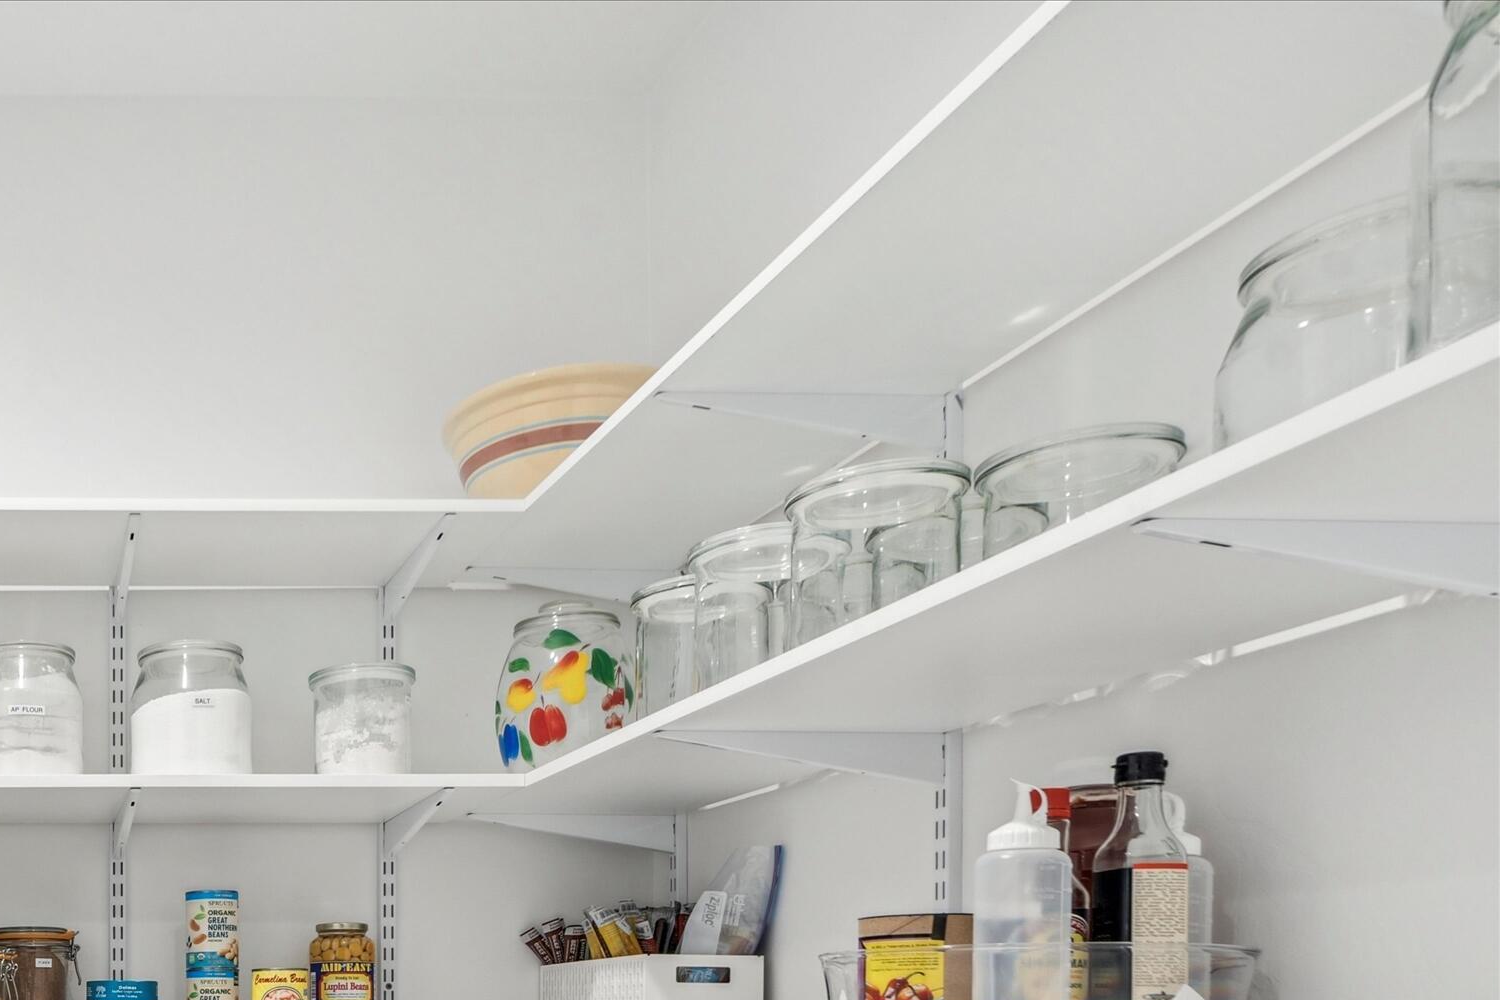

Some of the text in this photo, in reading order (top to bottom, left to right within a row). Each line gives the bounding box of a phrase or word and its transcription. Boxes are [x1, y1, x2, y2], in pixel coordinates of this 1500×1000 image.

[704, 896, 720, 927] Ziploc
[324, 982, 369, 992] Lupini Beans
